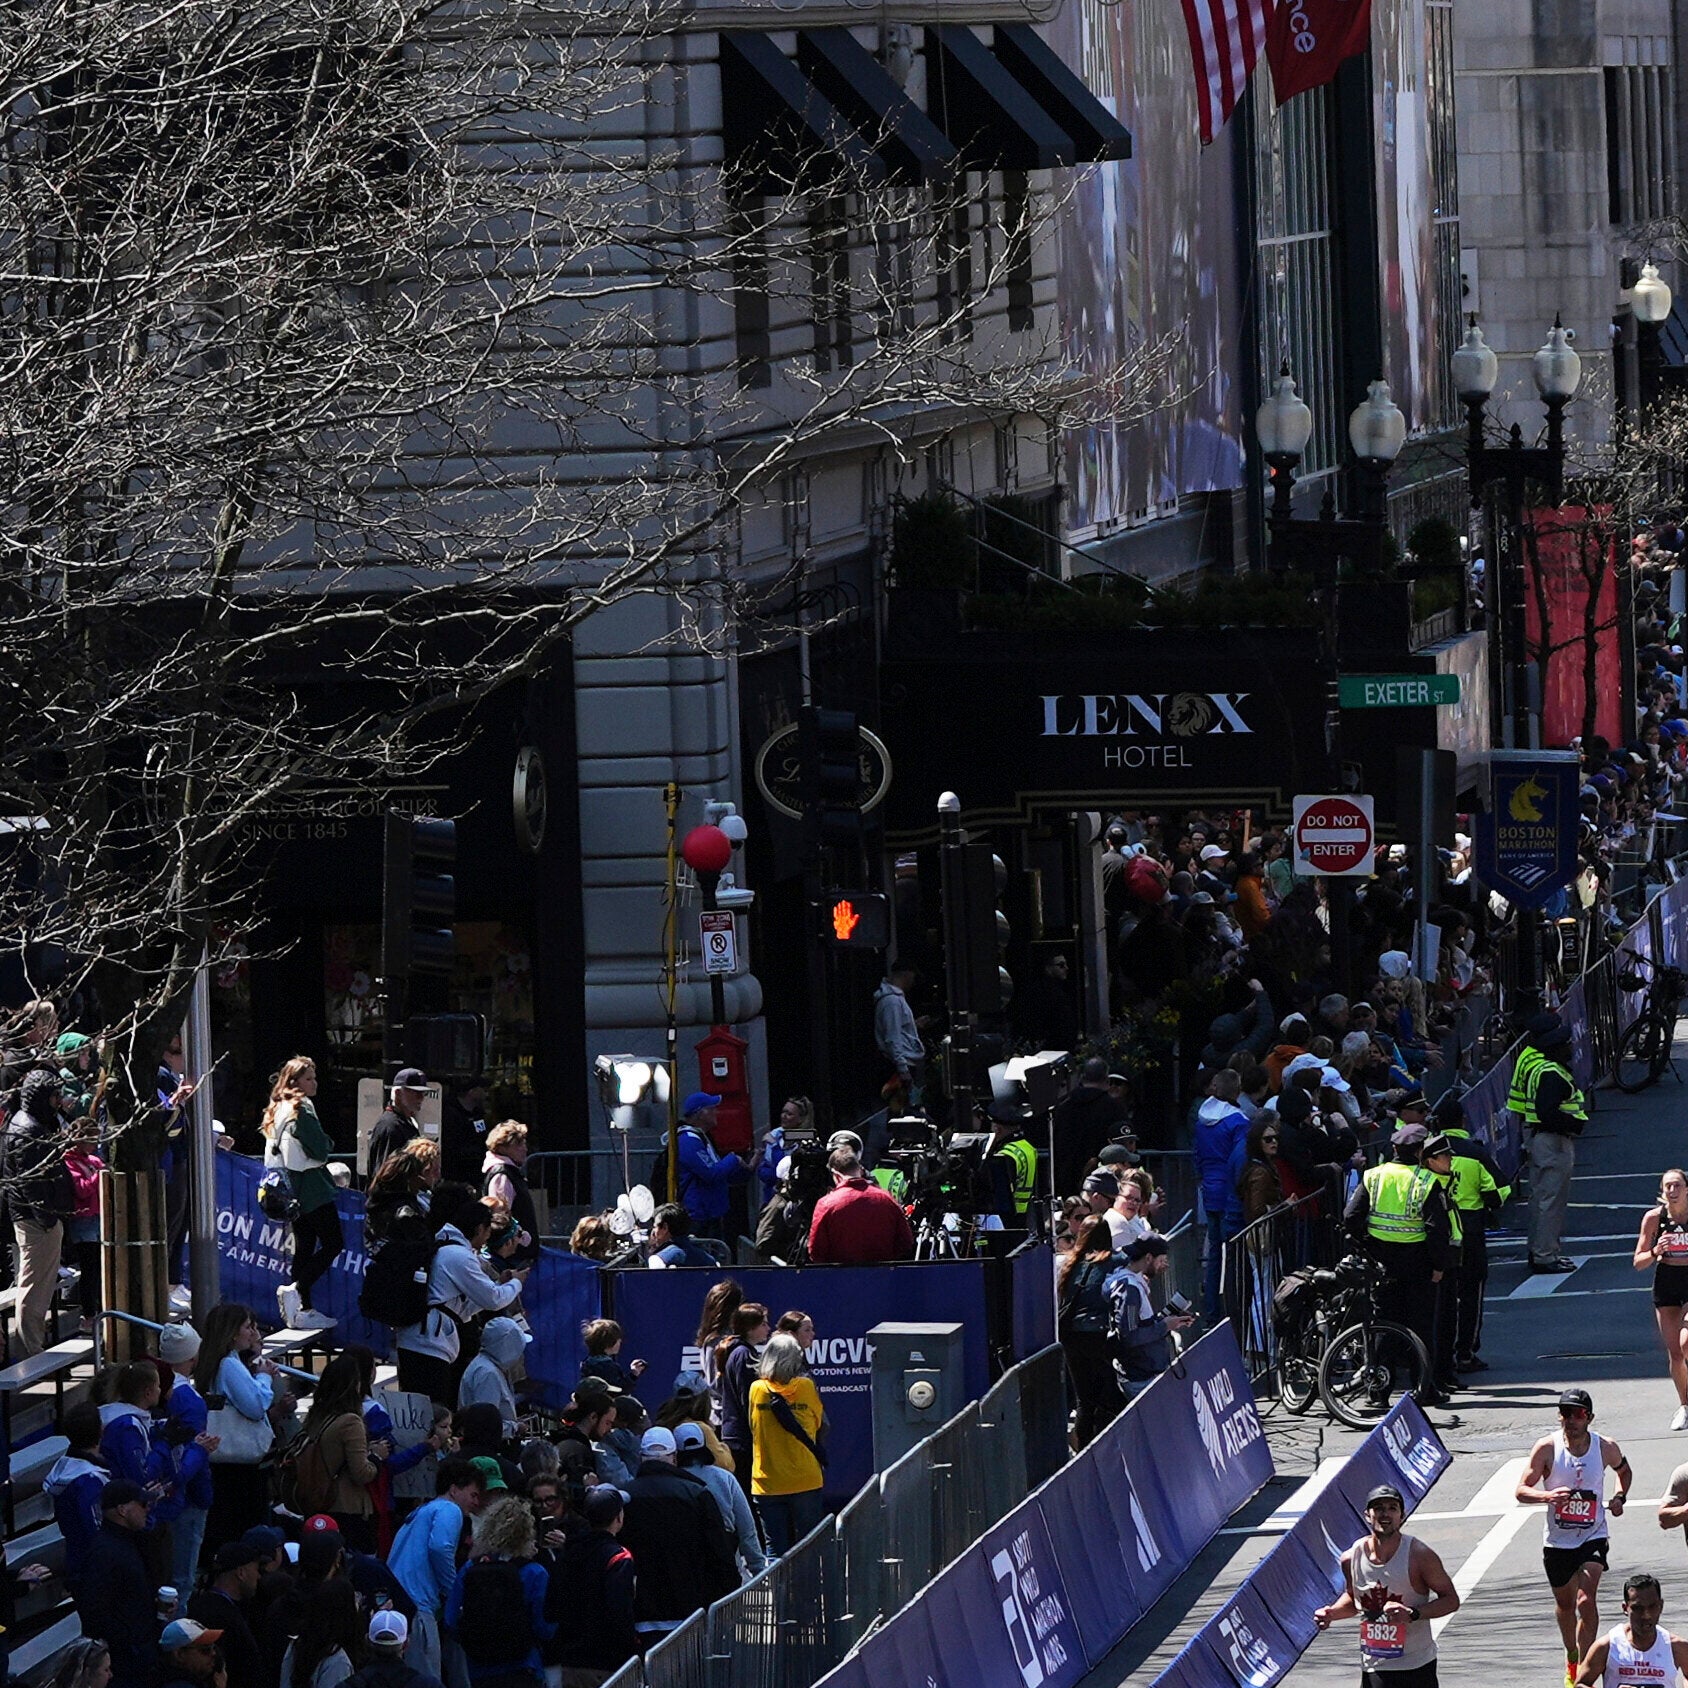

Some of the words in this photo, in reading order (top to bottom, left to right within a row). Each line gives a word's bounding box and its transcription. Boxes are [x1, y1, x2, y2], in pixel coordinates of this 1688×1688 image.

[1364, 683, 1428, 706] EXETER
[1433, 694, 1444, 705] ST
[1103, 747, 1192, 767] HOTEL
[1306, 816, 1327, 828] DO
[1334, 815, 1359, 828] NOT
[1497, 826, 1555, 838] BOSTON
[1313, 845, 1355, 857] ENTER
[1498, 841, 1555, 854] MARATHON
[259, 1223, 376, 1278] MATHO
[812, 1366, 850, 1377] OSTON'S
[852, 1366, 871, 1377] NEW
